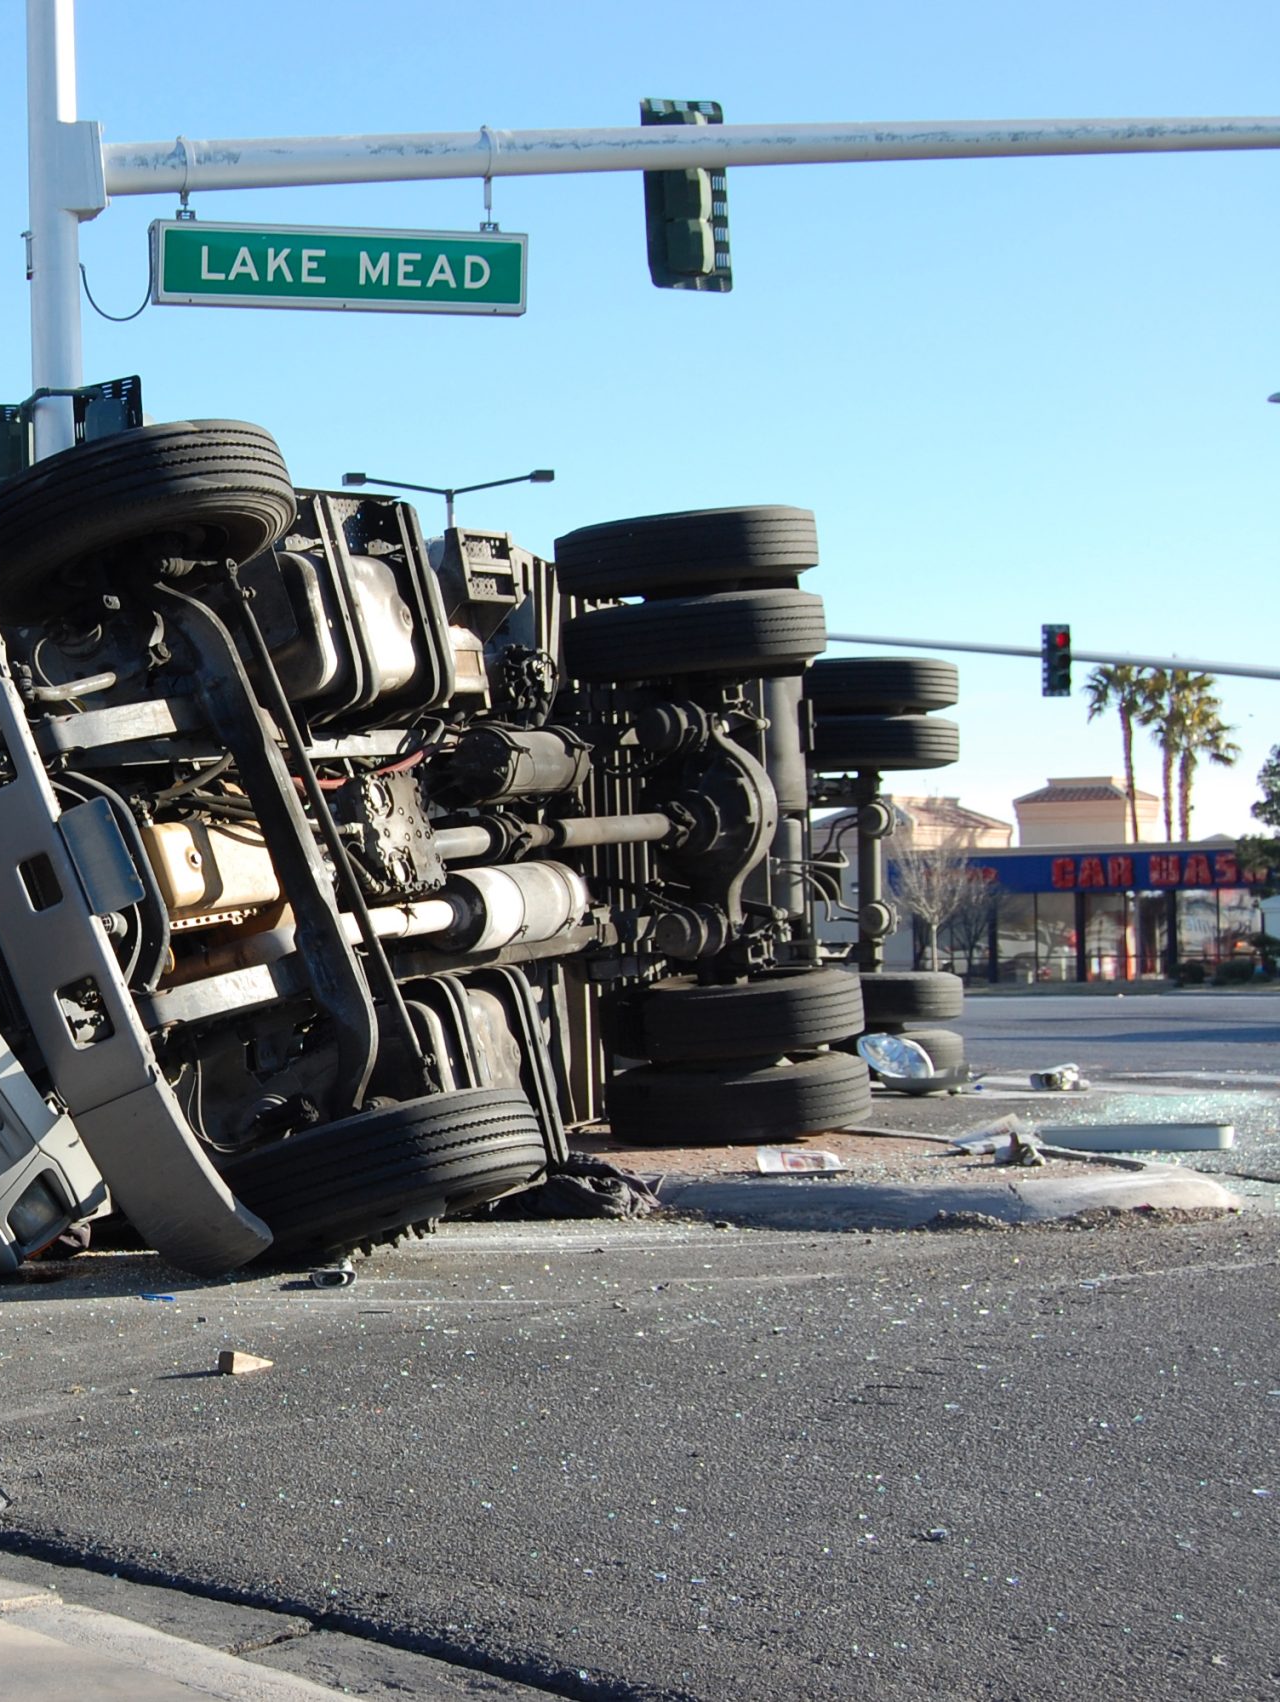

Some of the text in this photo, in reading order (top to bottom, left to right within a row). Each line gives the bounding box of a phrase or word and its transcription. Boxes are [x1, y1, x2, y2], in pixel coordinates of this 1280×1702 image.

[201, 245, 491, 289] LAKE MEAD
[1051, 856, 1134, 888] CAR
